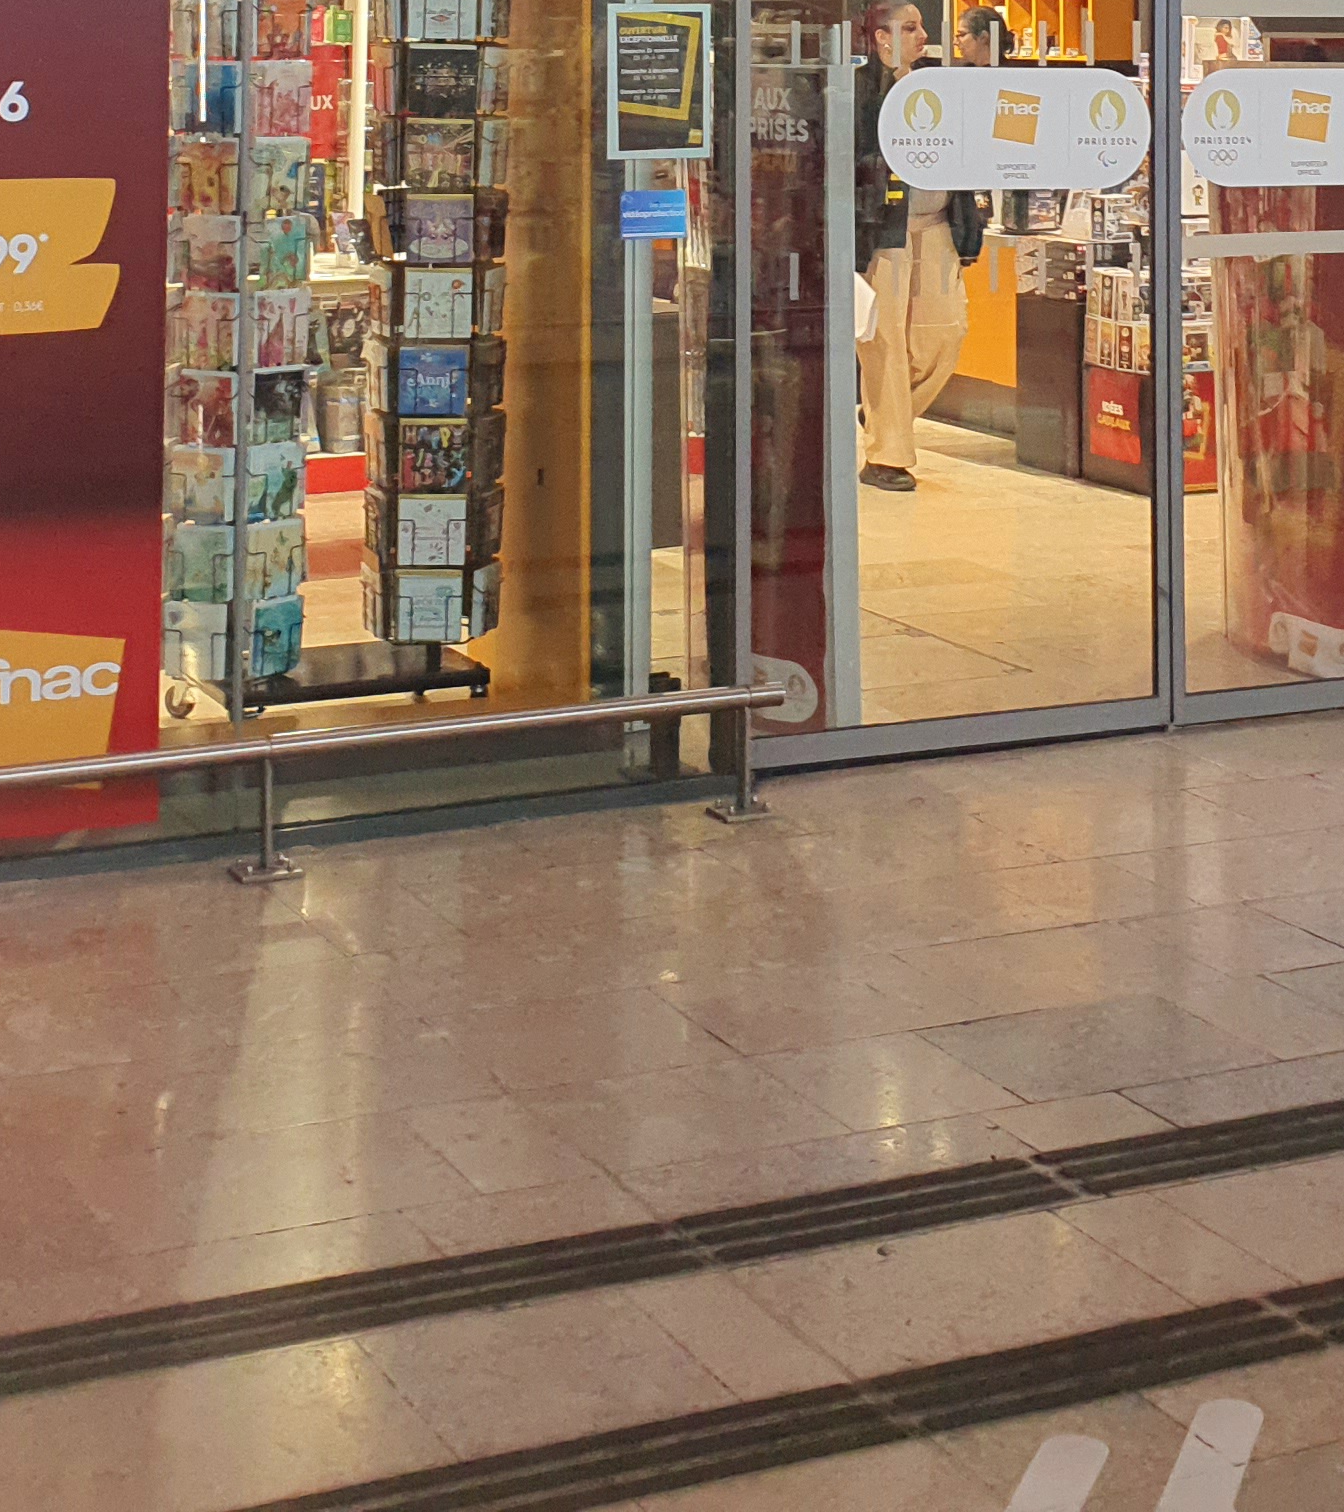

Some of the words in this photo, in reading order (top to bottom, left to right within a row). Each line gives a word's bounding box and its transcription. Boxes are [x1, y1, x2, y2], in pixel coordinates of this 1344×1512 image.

[754, 87, 792, 111] AUX
[995, 99, 1041, 115] fnac
[1291, 99, 1332, 114] fnac
[892, 138, 923, 146] PARIS
[925, 138, 954, 146] 2024
[1077, 137, 1107, 145] PARIS
[1110, 137, 1138, 145] 2024
[1194, 136, 1223, 144] PARIS
[1225, 136, 1252, 144] 2024
